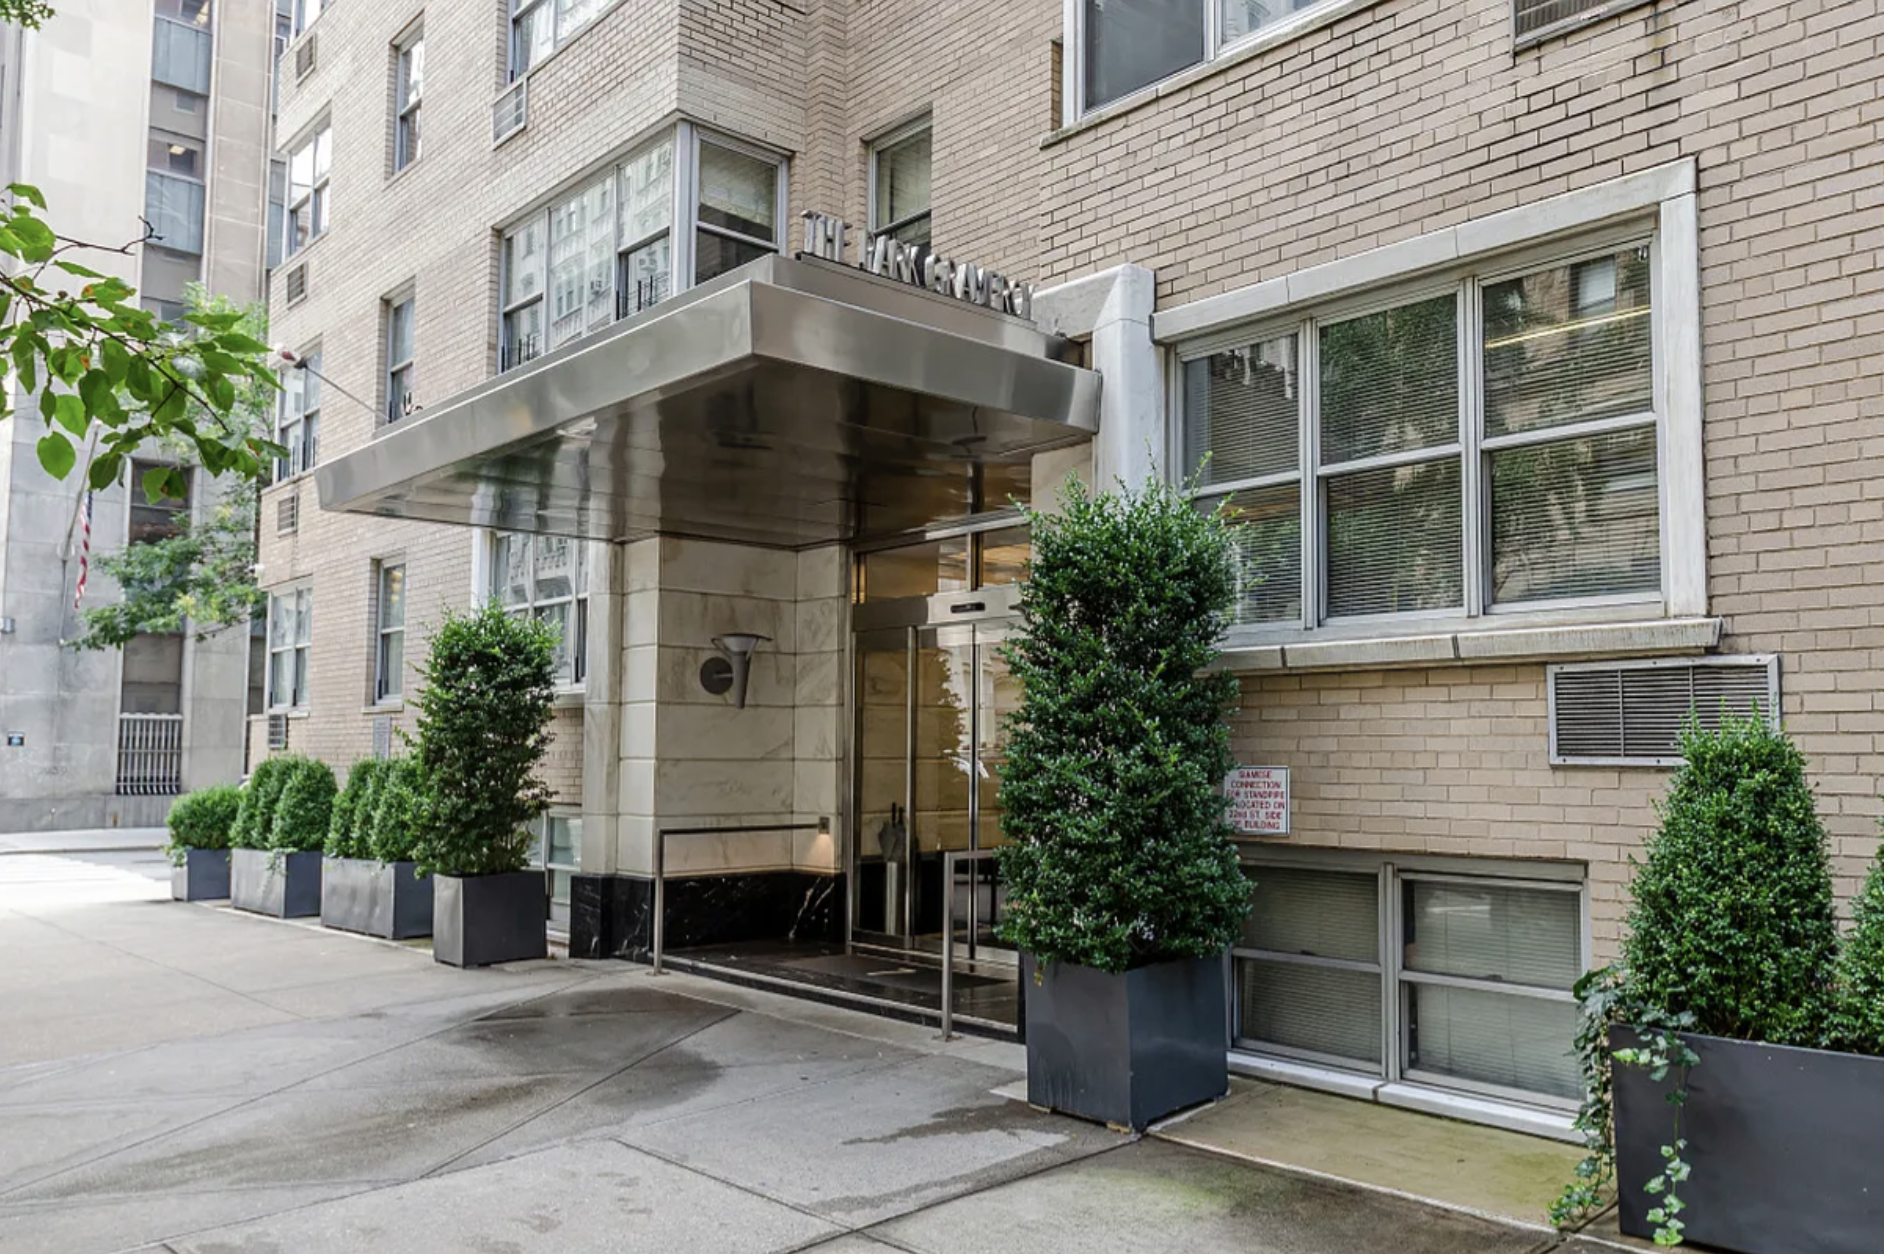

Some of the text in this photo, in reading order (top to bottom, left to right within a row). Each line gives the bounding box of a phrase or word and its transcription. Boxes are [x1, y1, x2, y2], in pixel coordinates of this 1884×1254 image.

[858, 228, 920, 287] PARK
[1230, 780, 1282, 789] CONNECTION
[1244, 790, 1285, 799] STANDPIPE
[1273, 801, 1286, 810] ON
[1244, 820, 1281, 830] BUILDING
